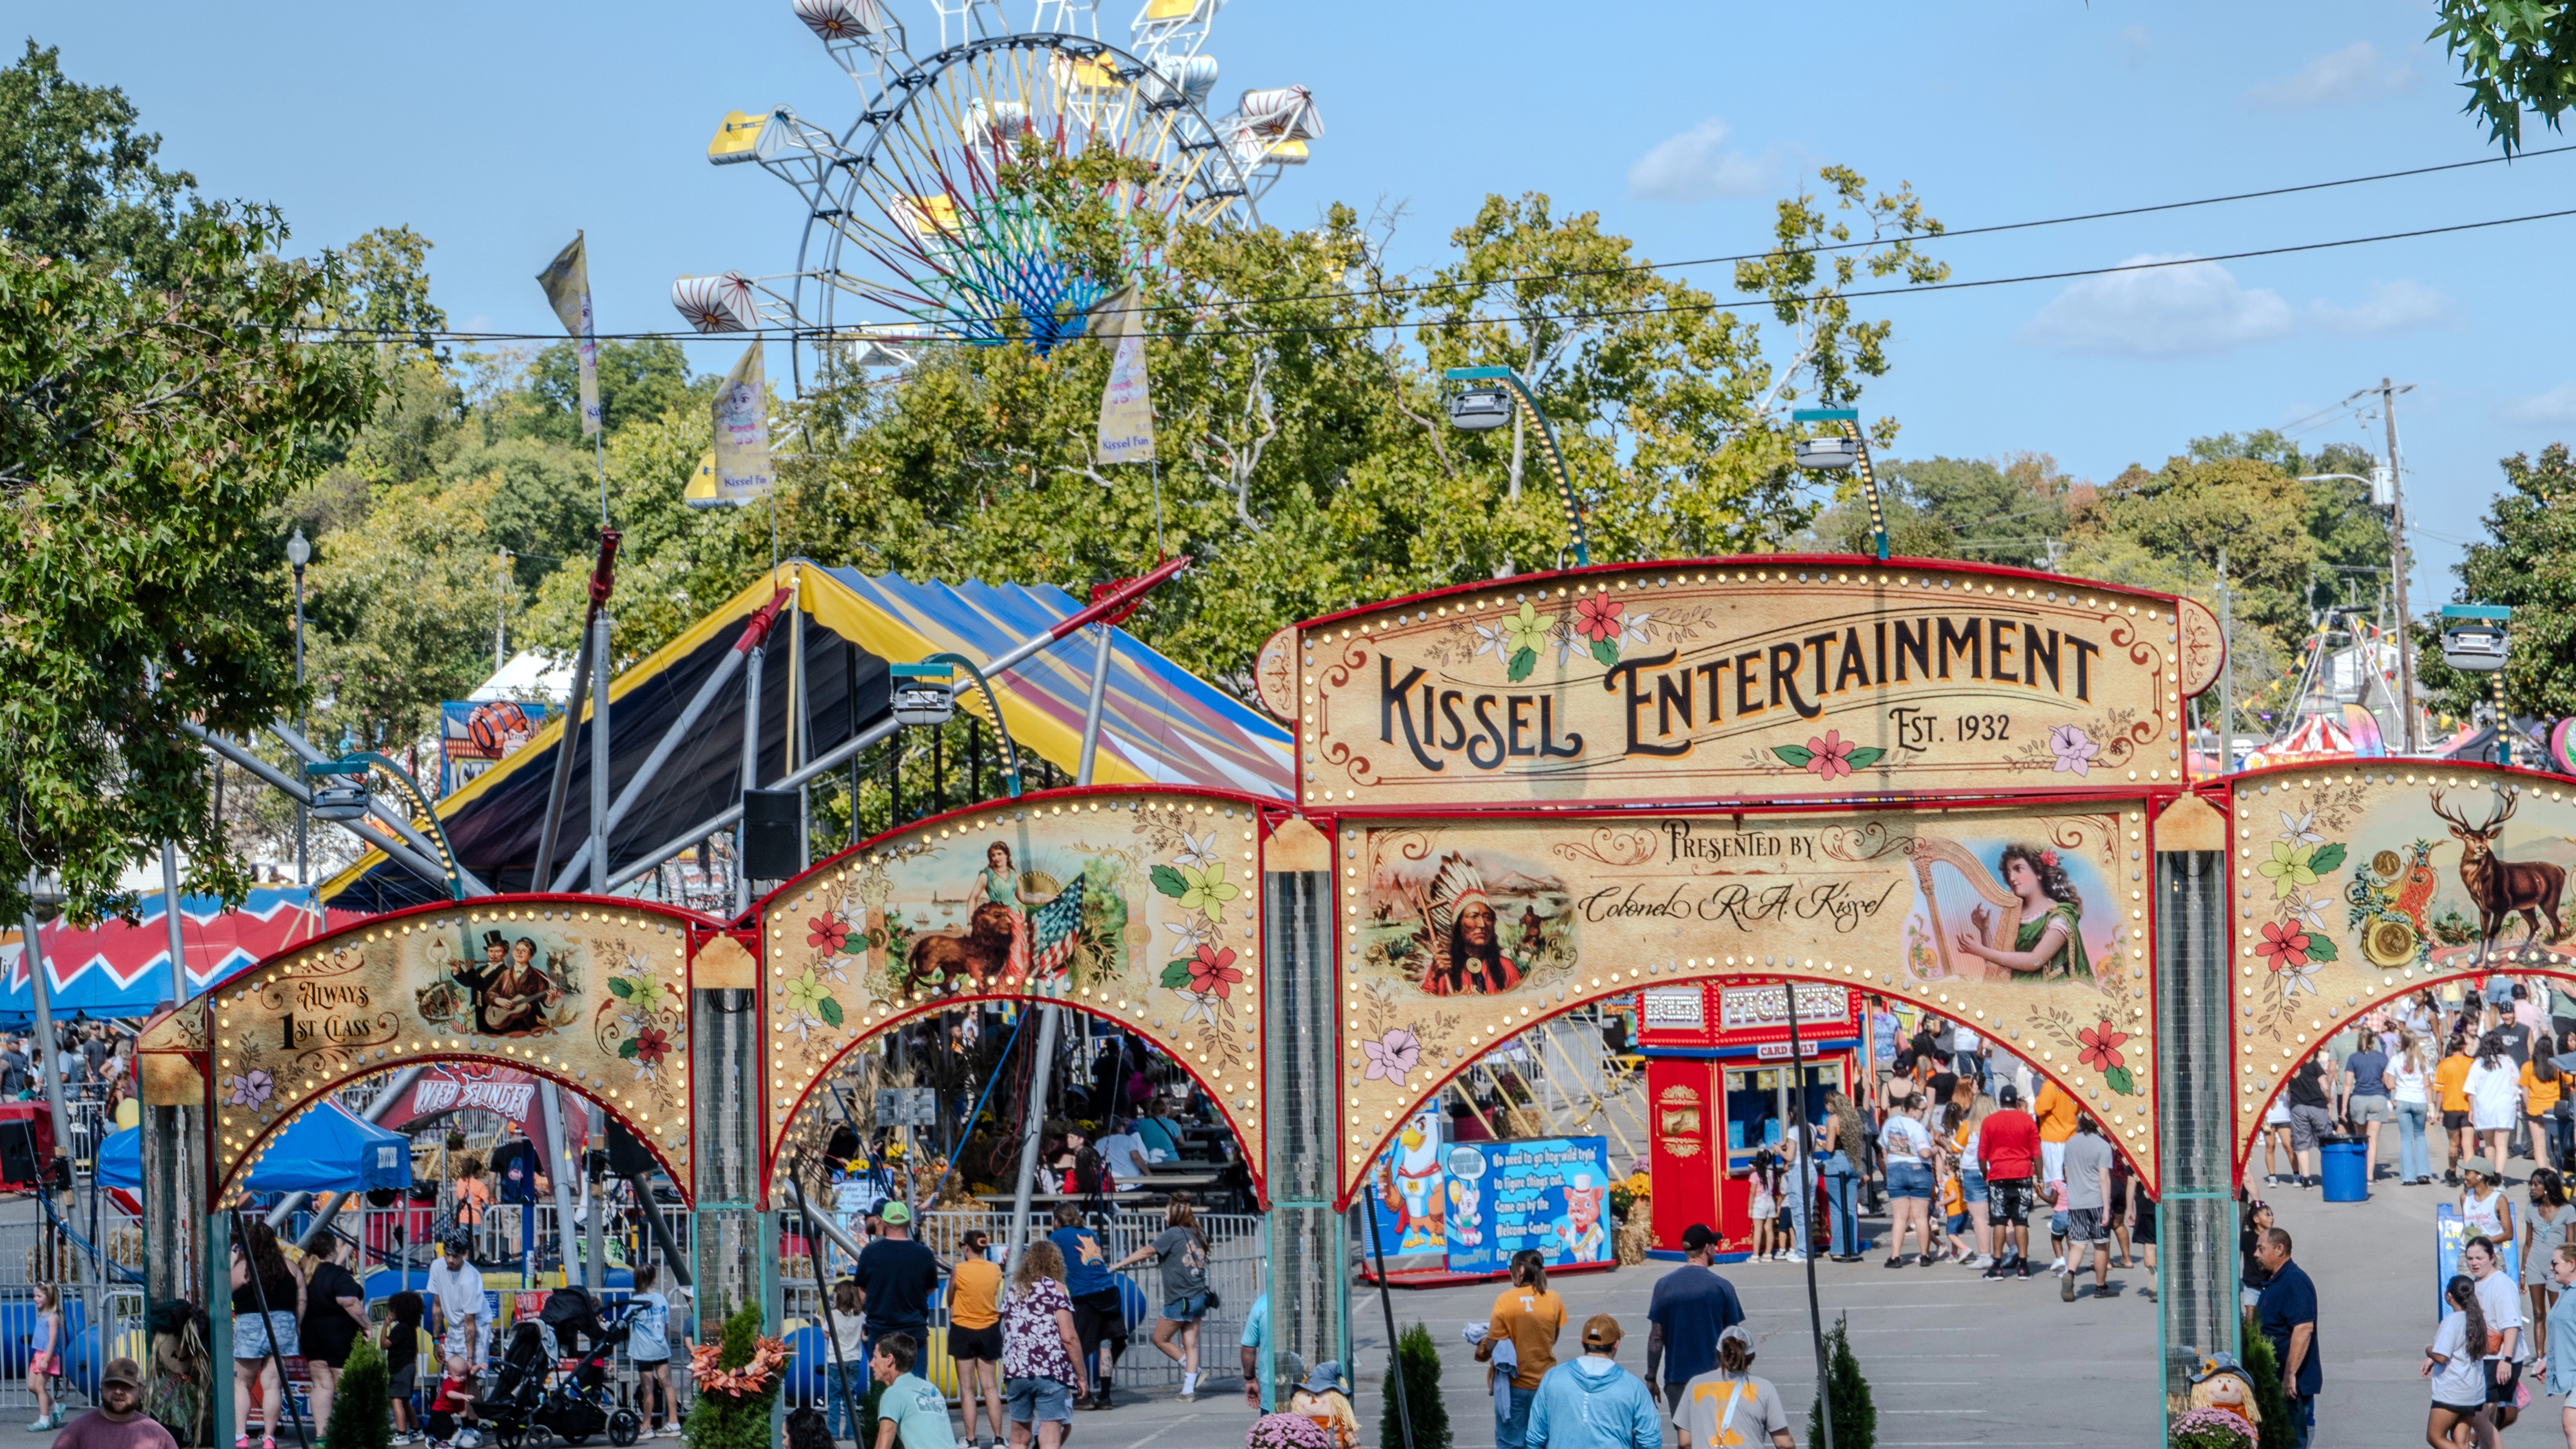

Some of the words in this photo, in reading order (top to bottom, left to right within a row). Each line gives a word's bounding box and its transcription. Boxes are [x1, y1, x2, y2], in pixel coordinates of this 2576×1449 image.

[1102, 437, 1130, 450] Kissel
[1133, 436, 1149, 447] Fun
[724, 475, 753, 488] Kissel
[1603, 616, 2102, 758] ENTERTAINMENT
[1957, 714, 2010, 742] 1932
[1661, 818, 1781, 865] PRESENTED
[1790, 835, 1817, 863] BY
[1578, 882, 1691, 923] Colonel
[1795, 879, 1904, 933] Kissel
[297, 982, 369, 1012] ALWAYS
[1644, 995, 1700, 1021] TICKETS
[1726, 985, 1845, 1023] TICKETS
[324, 1015, 371, 1043] CLASS
[1760, 1046, 1788, 1056] CARD
[413, 1079, 460, 1115] WEB
[458, 1082, 534, 1123] SLINGER
[1492, 1153, 1504, 1168] No
[1505, 1150, 1522, 1167] need
[1523, 1150, 1533, 1164] to
[1533, 1152, 1544, 1169] go
[1578, 1145, 1598, 1166] tryin'
[1493, 1177, 1503, 1191] to
[1526, 1172, 1549, 1192] things
[1549, 1171, 1565, 1187] out.
[1494, 1198, 1515, 1214] Come
[1516, 1201, 1526, 1213] on
[1526, 1196, 1536, 1216] by
[1537, 1196, 1550, 1211] the
[1495, 1221, 1527, 1238] Welcome
[1528, 1221, 1551, 1235] Center
[2446, 1242, 2455, 1250] &
[1520, 1296, 1535, 1312] T
[1693, 1381, 1758, 1447] T
